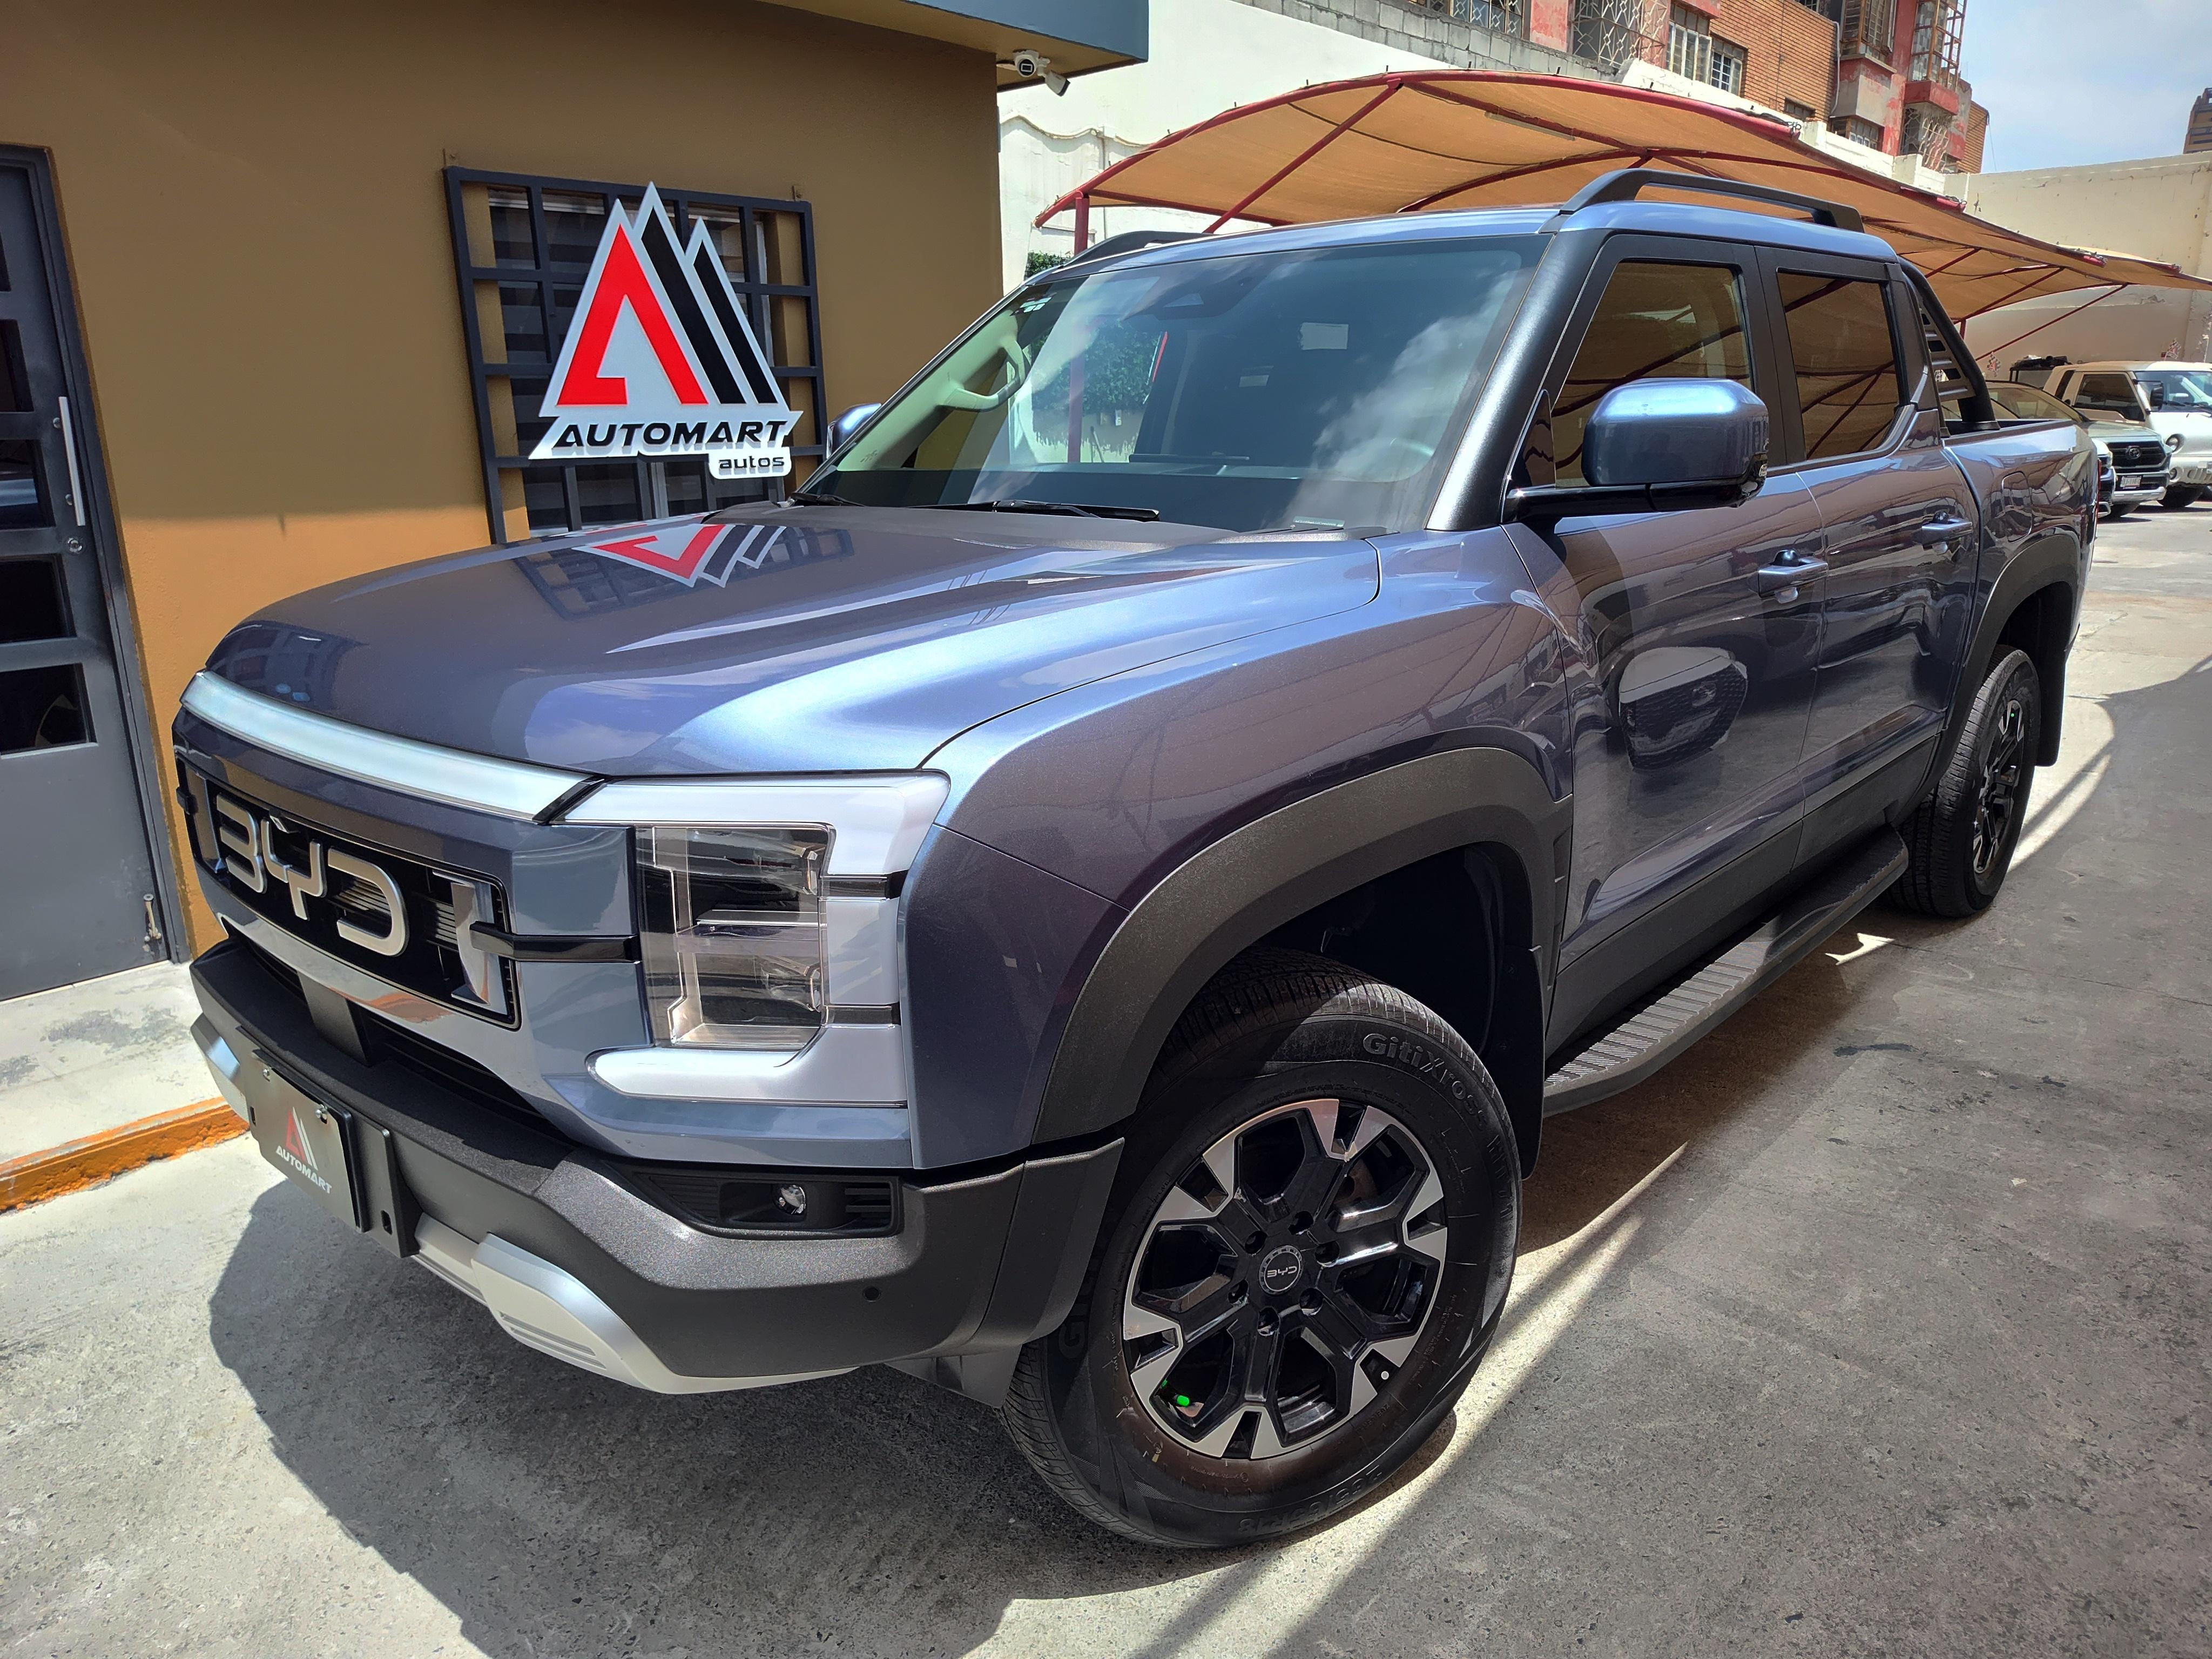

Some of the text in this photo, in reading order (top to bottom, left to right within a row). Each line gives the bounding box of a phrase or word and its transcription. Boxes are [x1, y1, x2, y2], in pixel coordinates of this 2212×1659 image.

[552, 421, 787, 449] AUTOMART
[719, 457, 784, 469] autos
[217, 794, 408, 956] BYD
[276, 1145, 332, 1194] AUTOMART
[1267, 1266, 1297, 1278] BYD
